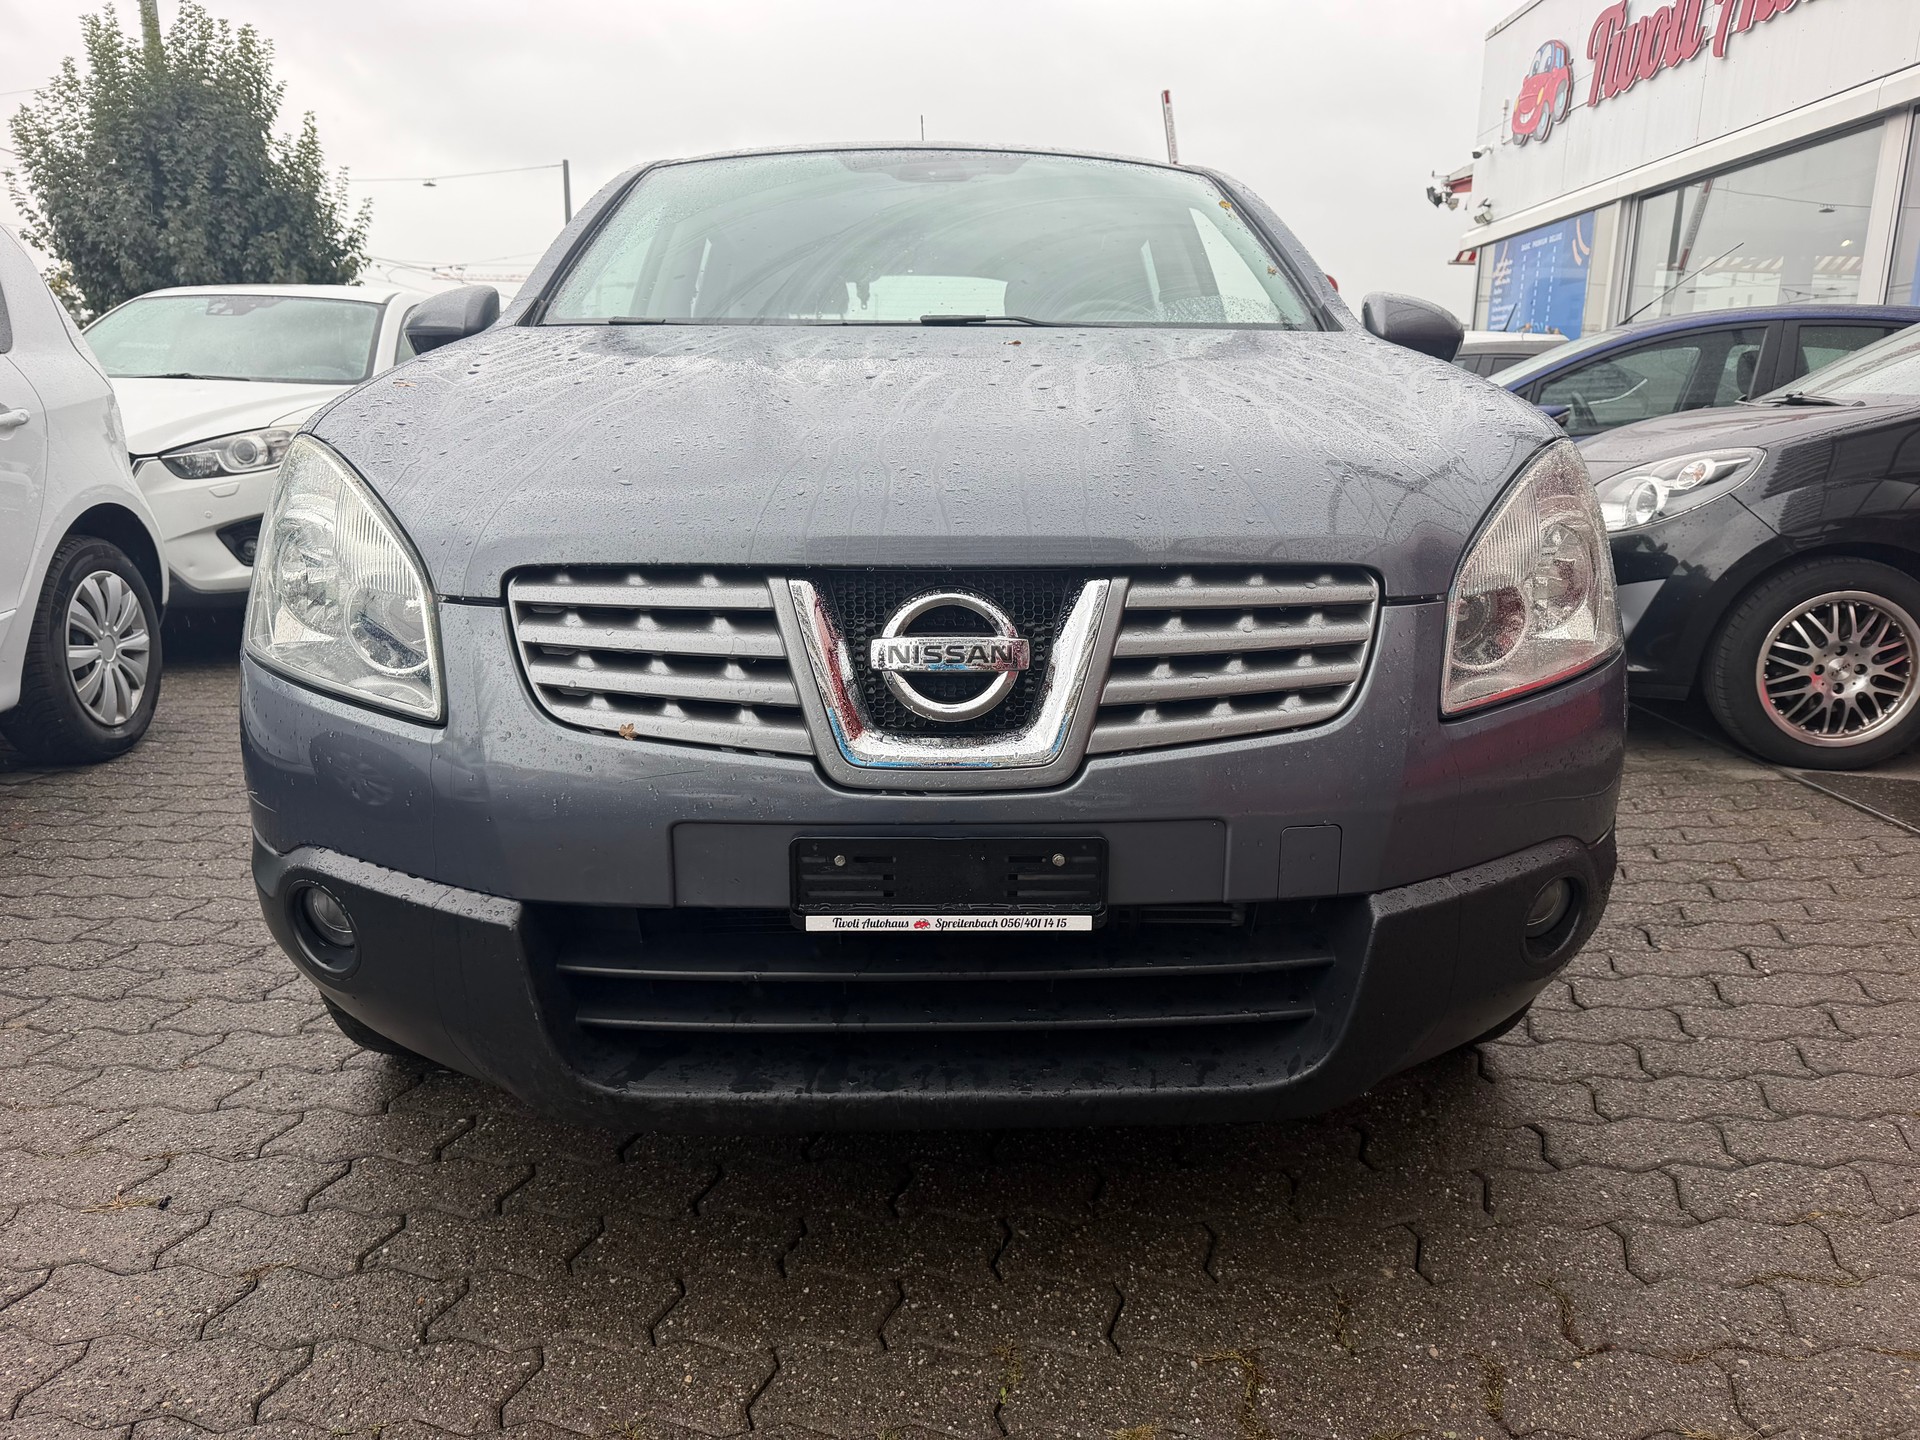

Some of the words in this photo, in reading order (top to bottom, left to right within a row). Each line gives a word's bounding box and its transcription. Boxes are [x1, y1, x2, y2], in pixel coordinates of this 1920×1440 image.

[887, 644, 1014, 665] NISSAN
[832, 917, 860, 929] Tivoli
[861, 918, 909, 930] Autohaus
[935, 917, 998, 932] Spreitenbach
[1000, 917, 1041, 929] 056/401
[1043, 917, 1054, 929] 14
[1056, 917, 1068, 929] 15
